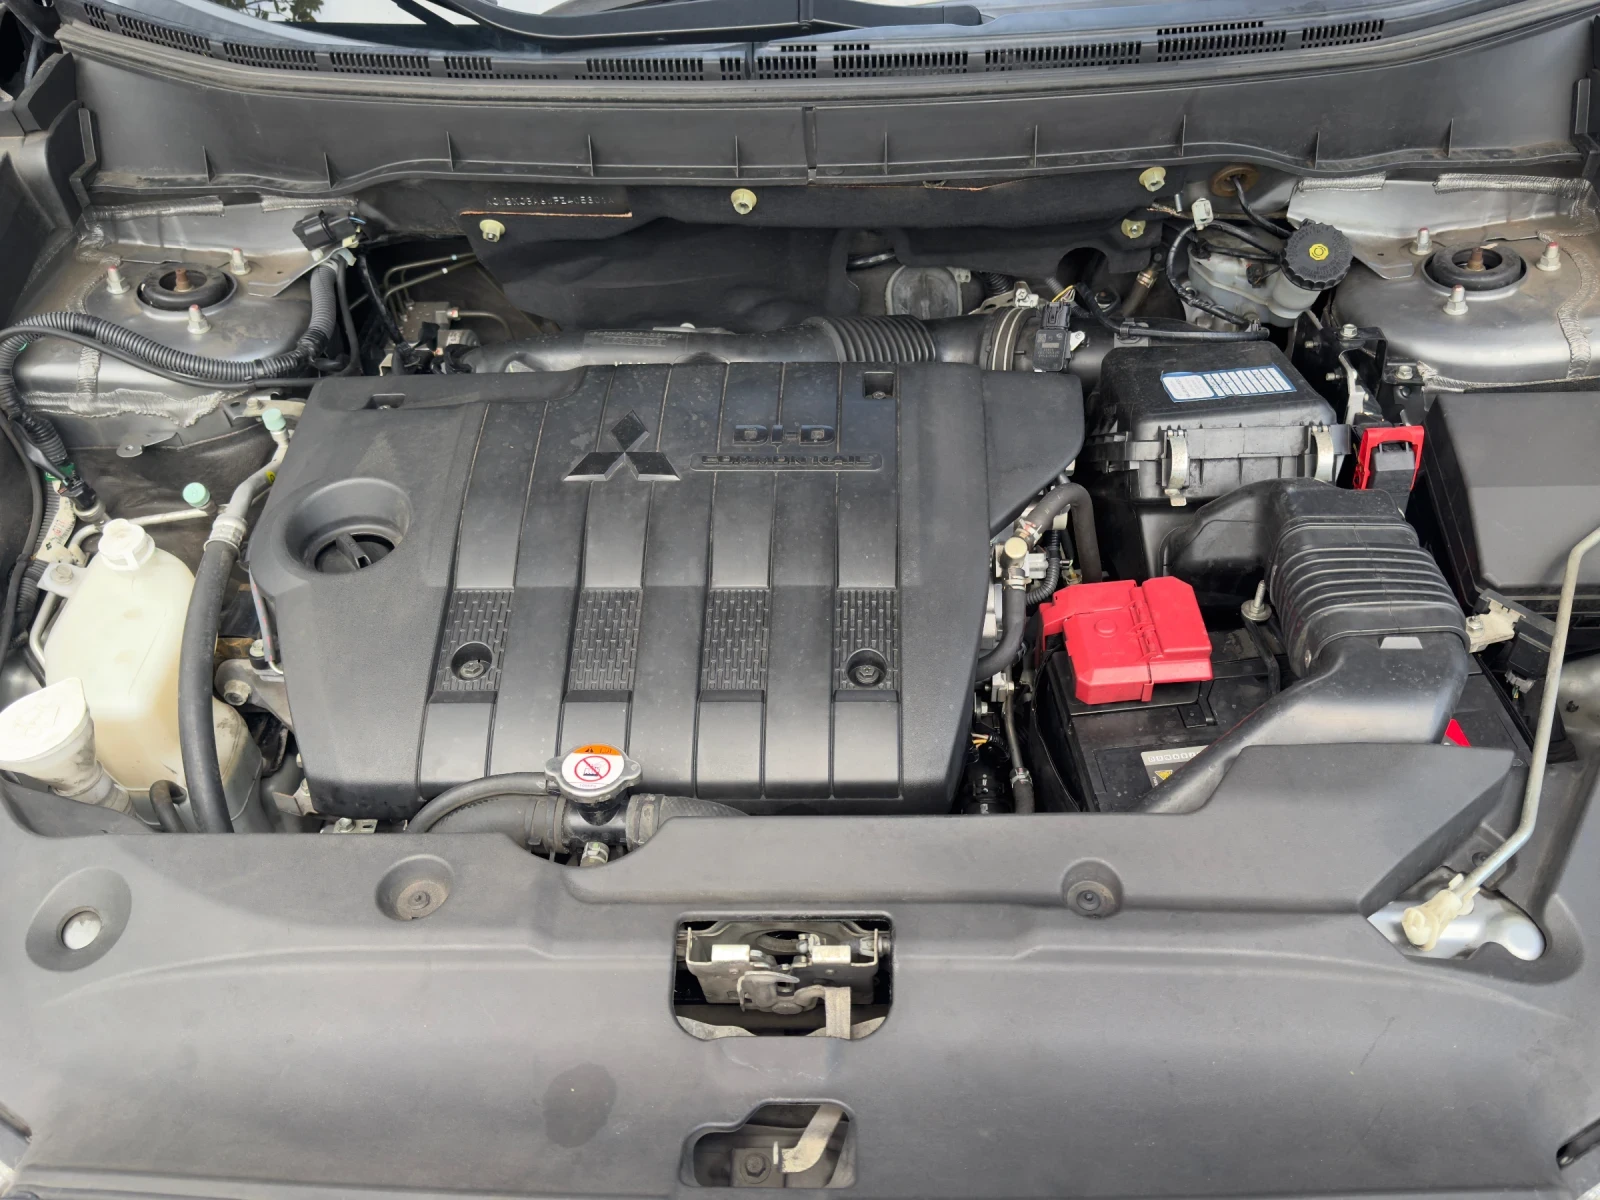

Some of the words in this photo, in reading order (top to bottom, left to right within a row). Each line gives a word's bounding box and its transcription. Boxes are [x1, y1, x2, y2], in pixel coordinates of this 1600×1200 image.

[732, 424, 837, 446] DI-D
[701, 455, 806, 467] COMMON
[812, 455, 872, 467] RAIL
